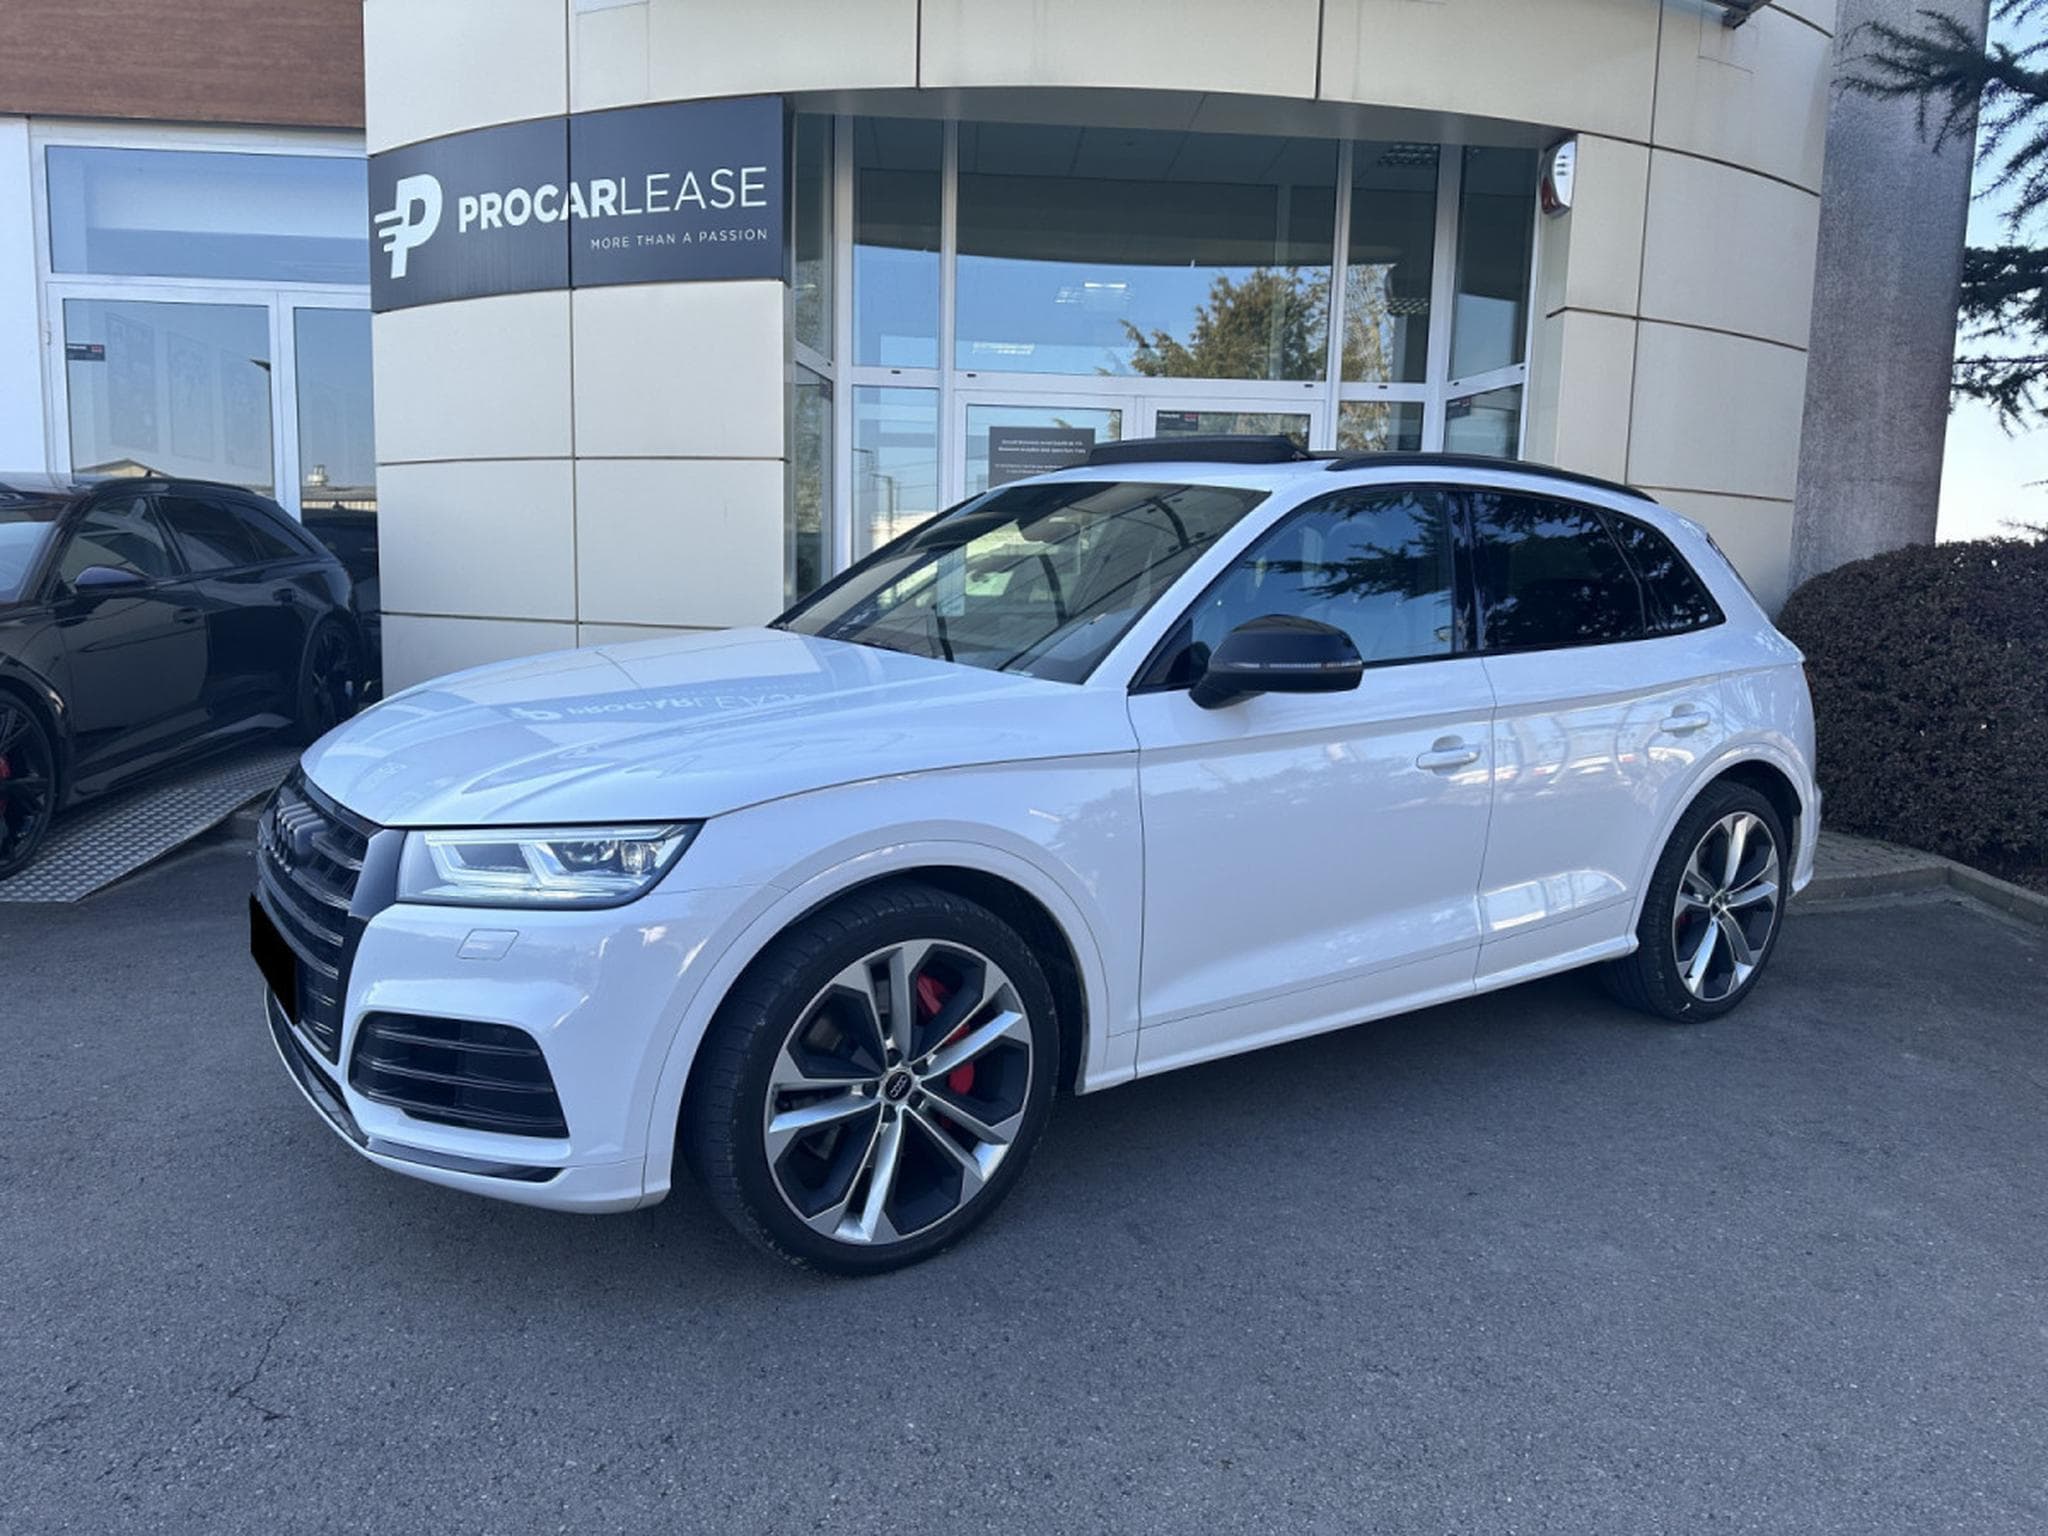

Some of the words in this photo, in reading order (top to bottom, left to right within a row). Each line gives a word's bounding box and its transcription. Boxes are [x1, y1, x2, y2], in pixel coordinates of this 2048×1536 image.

[459, 167, 768, 233] PROCARLEASE
[591, 236, 630, 249] MORE
[637, 233, 676, 246] THAN
[682, 232, 692, 244] A
[699, 228, 768, 243] PASSION
